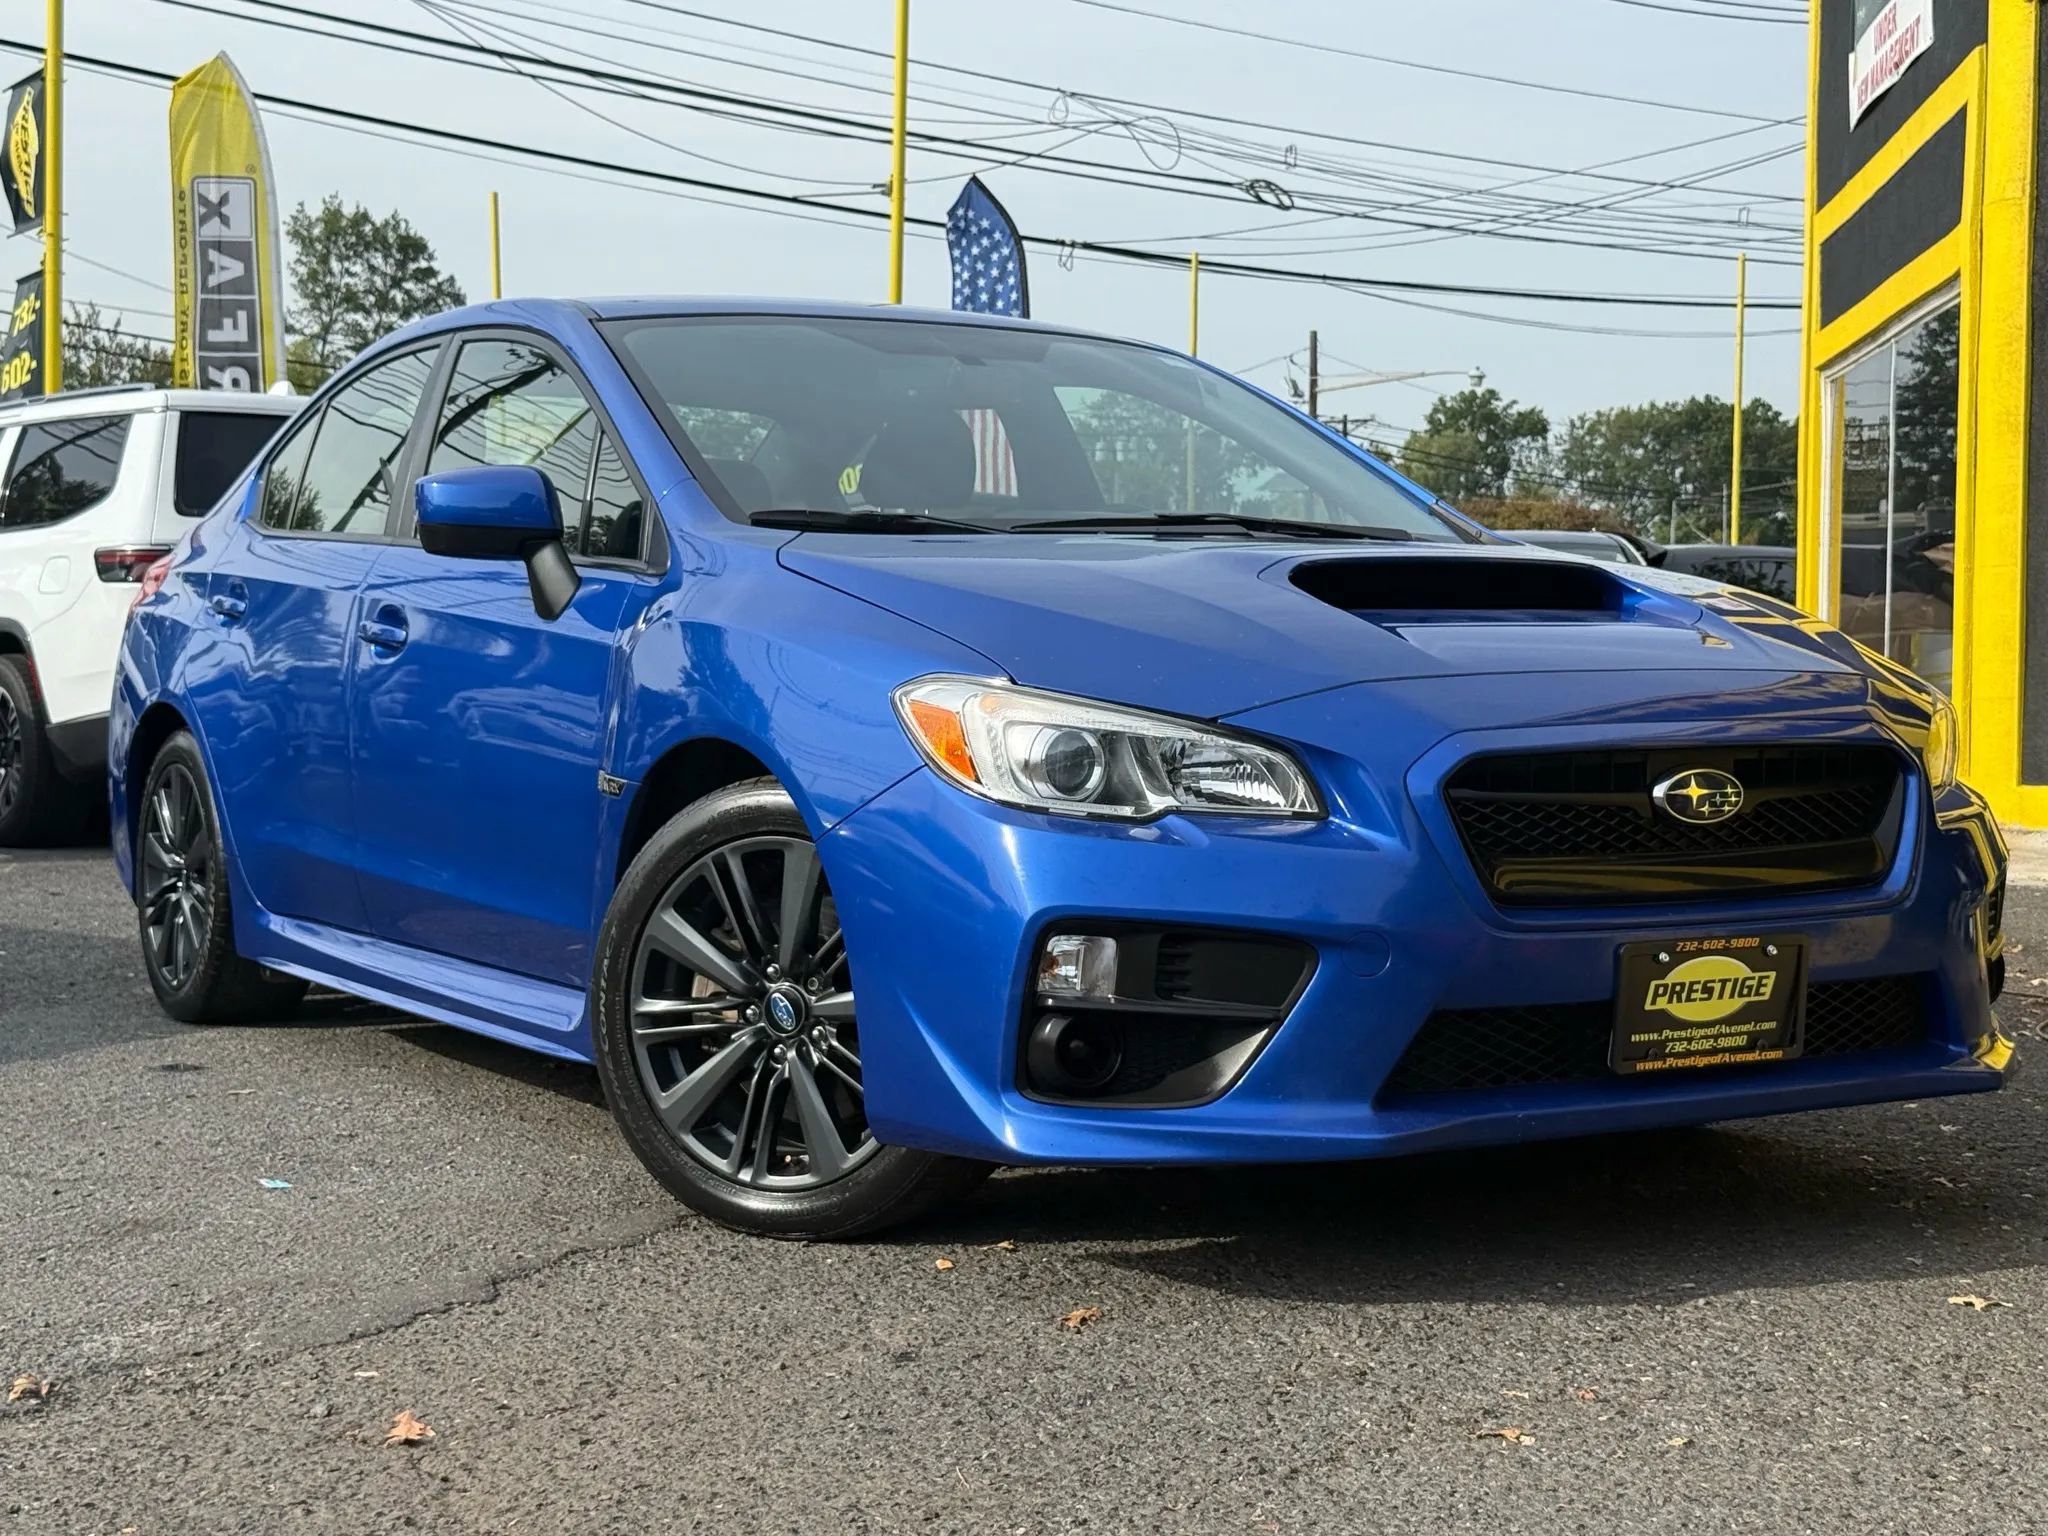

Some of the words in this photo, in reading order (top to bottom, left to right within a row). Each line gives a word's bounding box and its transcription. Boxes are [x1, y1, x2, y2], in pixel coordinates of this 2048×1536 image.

[13, 292, 41, 337] 732-
[1, 351, 37, 395] 602-
[1675, 937, 1761, 952] 732-602-9800
[1650, 974, 1771, 1007] PRESTIGE
[1631, 1020, 1777, 1043] www.PrestigeofAvenel.com
[1664, 1035, 1748, 1054] 732-602-9800
[1635, 1049, 1784, 1072] www.PrestigeofAvenel.com
